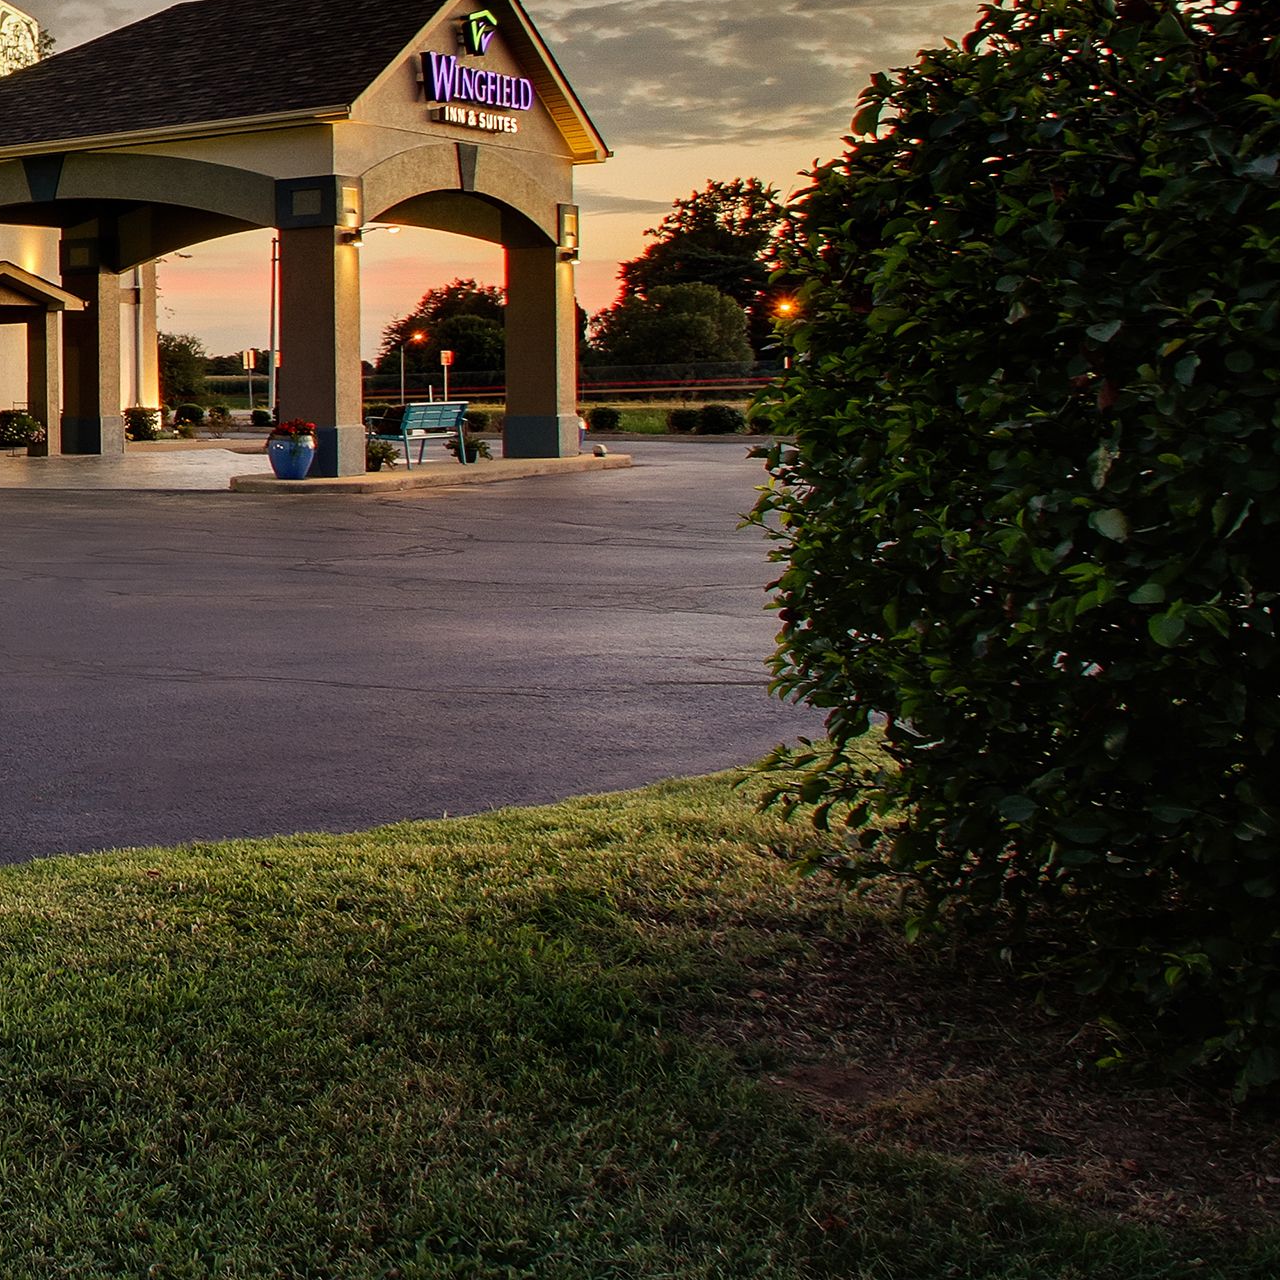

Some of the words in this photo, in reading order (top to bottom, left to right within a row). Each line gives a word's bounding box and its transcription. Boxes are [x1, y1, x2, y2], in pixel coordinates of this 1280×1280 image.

[430, 52, 533, 110] WINGFIELD
[445, 106, 466, 124] INN
[468, 110, 477, 126] &
[479, 112, 518, 133] SUITES
